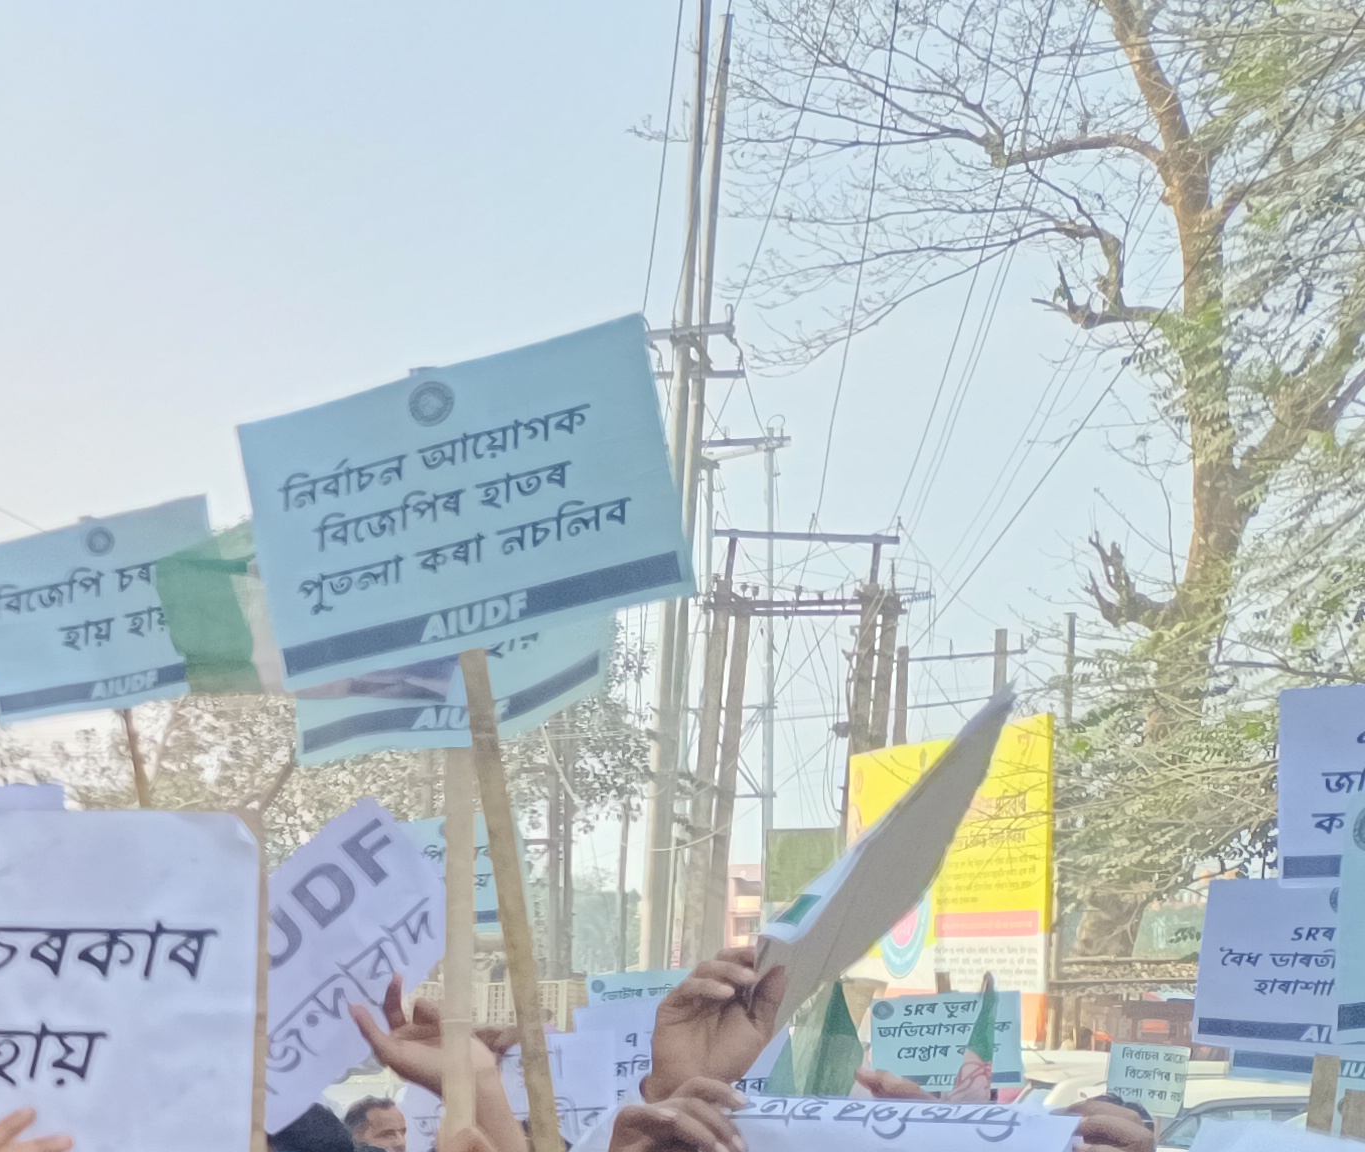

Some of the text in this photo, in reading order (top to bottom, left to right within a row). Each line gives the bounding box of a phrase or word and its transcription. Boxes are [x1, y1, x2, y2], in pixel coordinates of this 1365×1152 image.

[417, 402, 591, 473] আয়োগক
[315, 460, 572, 552] বিজেপিৰ হাতৰ
[297, 495, 633, 615] পুতলা কৰা নচলিব
[59, 617, 114, 651] হায়
[420, 590, 529, 644] AIUDF
[91, 670, 159, 699] AIUDF
[1219, 947, 1336, 969] বৈধ ভাৰতী
